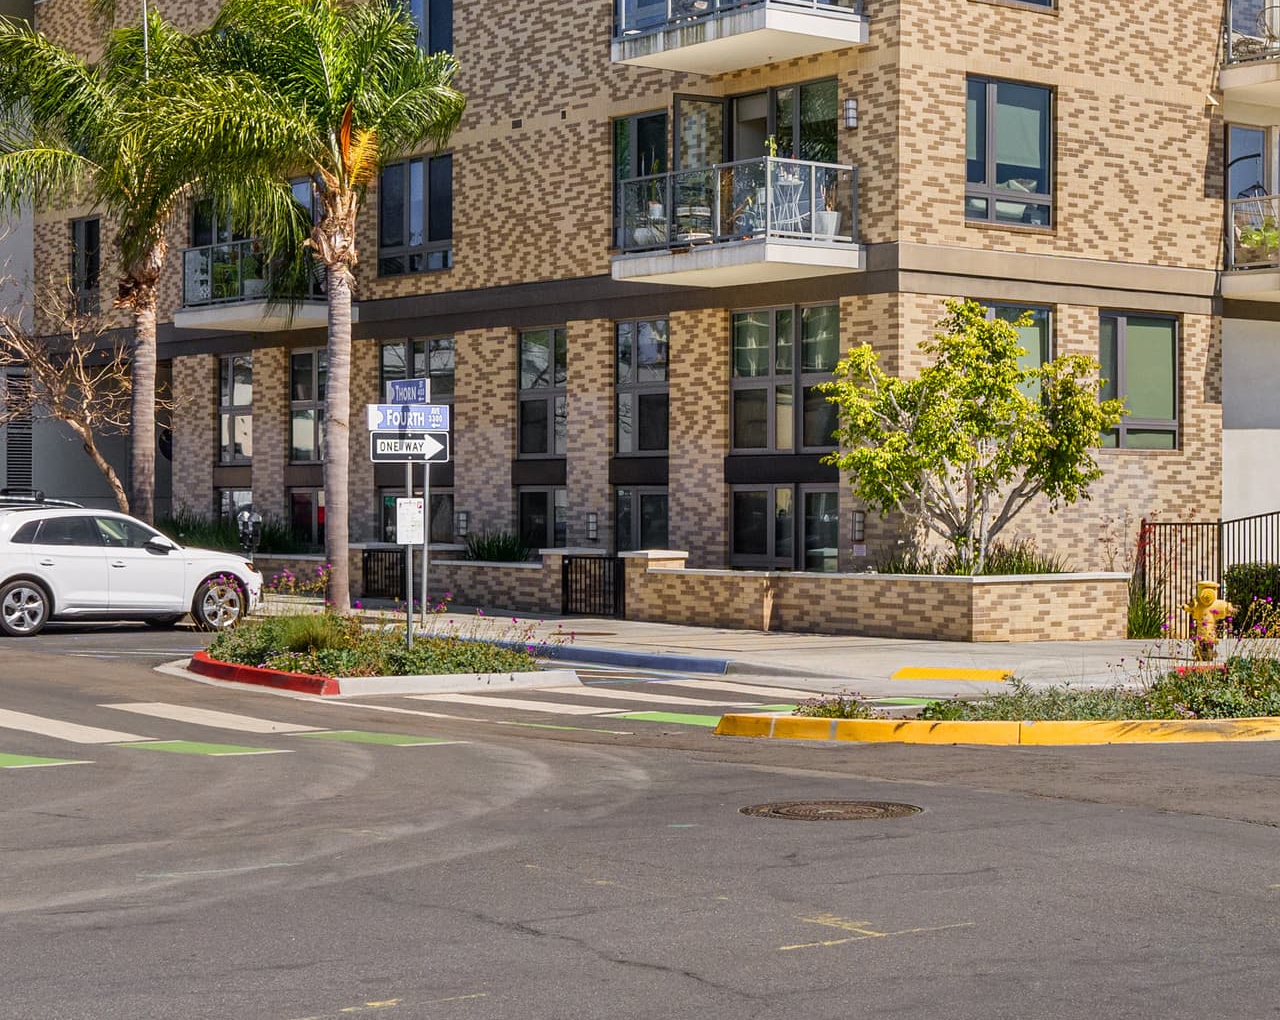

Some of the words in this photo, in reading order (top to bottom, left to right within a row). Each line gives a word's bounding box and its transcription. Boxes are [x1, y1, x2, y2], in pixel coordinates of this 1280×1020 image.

[395, 385, 417, 401] THORN
[386, 409, 425, 426] FOURTH
[380, 441, 399, 452] ONE
[405, 441, 425, 452] WAY
